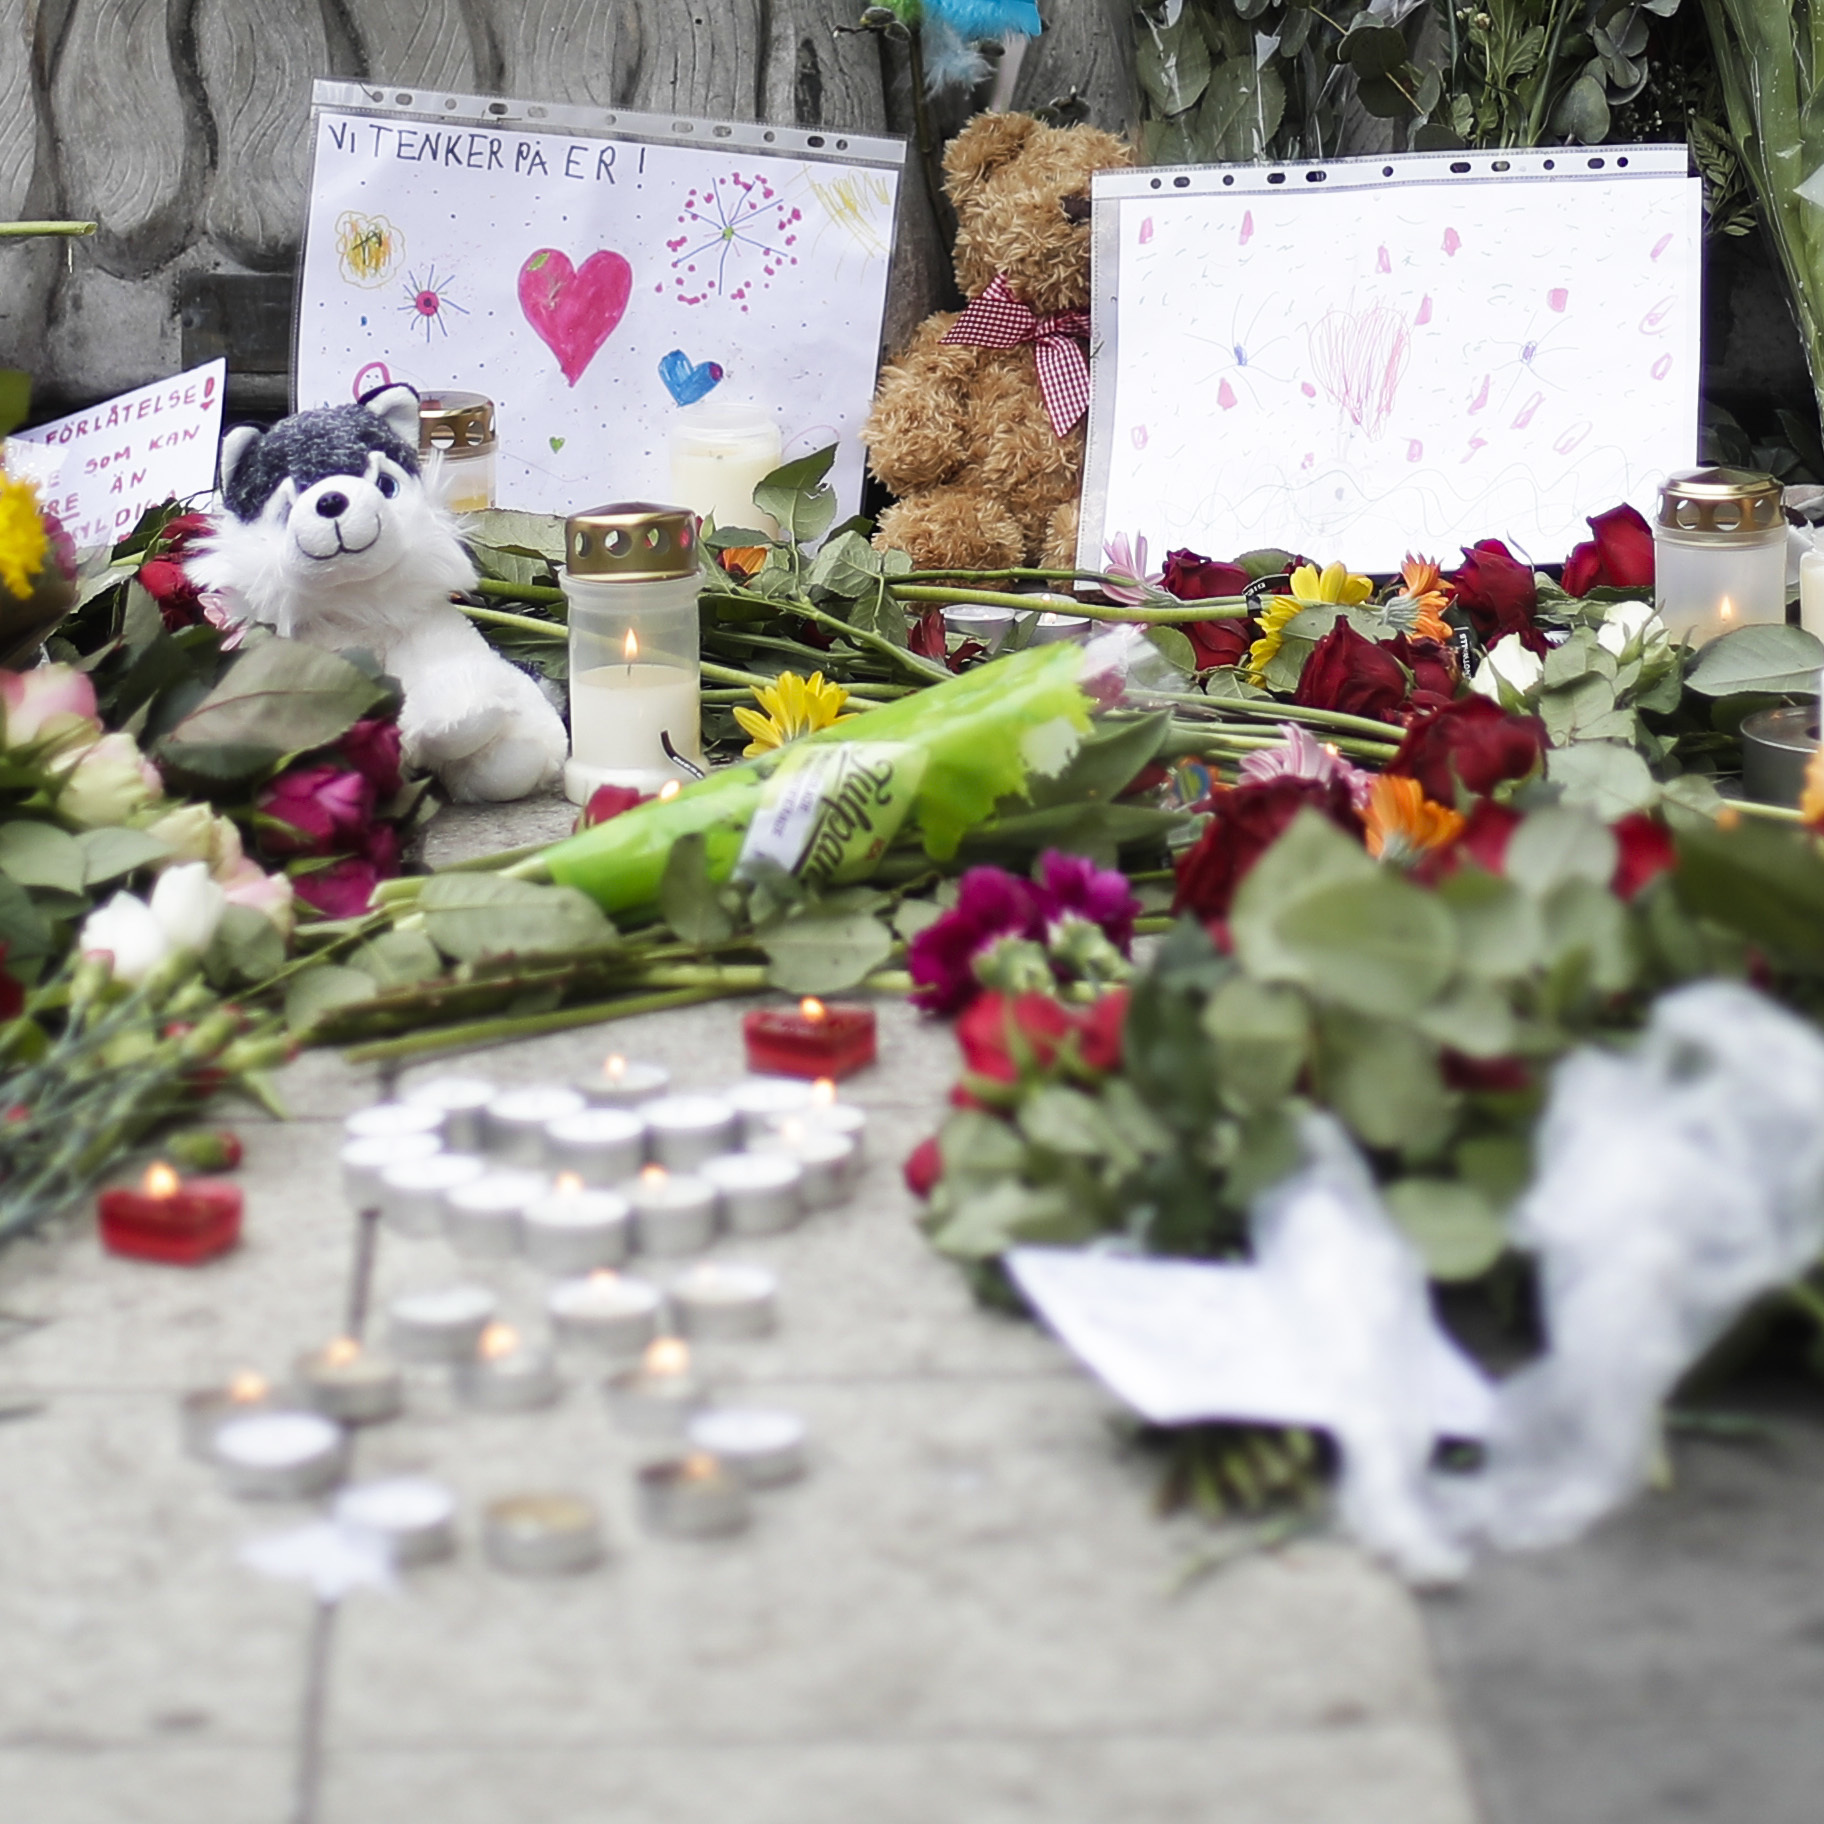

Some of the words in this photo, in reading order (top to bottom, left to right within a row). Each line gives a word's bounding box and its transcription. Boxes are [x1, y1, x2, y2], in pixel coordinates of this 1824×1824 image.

[328, 121, 356, 154] VI
[369, 123, 504, 171] TENKER
[514, 140, 549, 176] PÅ
[564, 144, 616, 185] ER
[84, 446, 131, 475] SOM
[147, 424, 201, 452] KAN
[109, 468, 147, 494] ÄN
